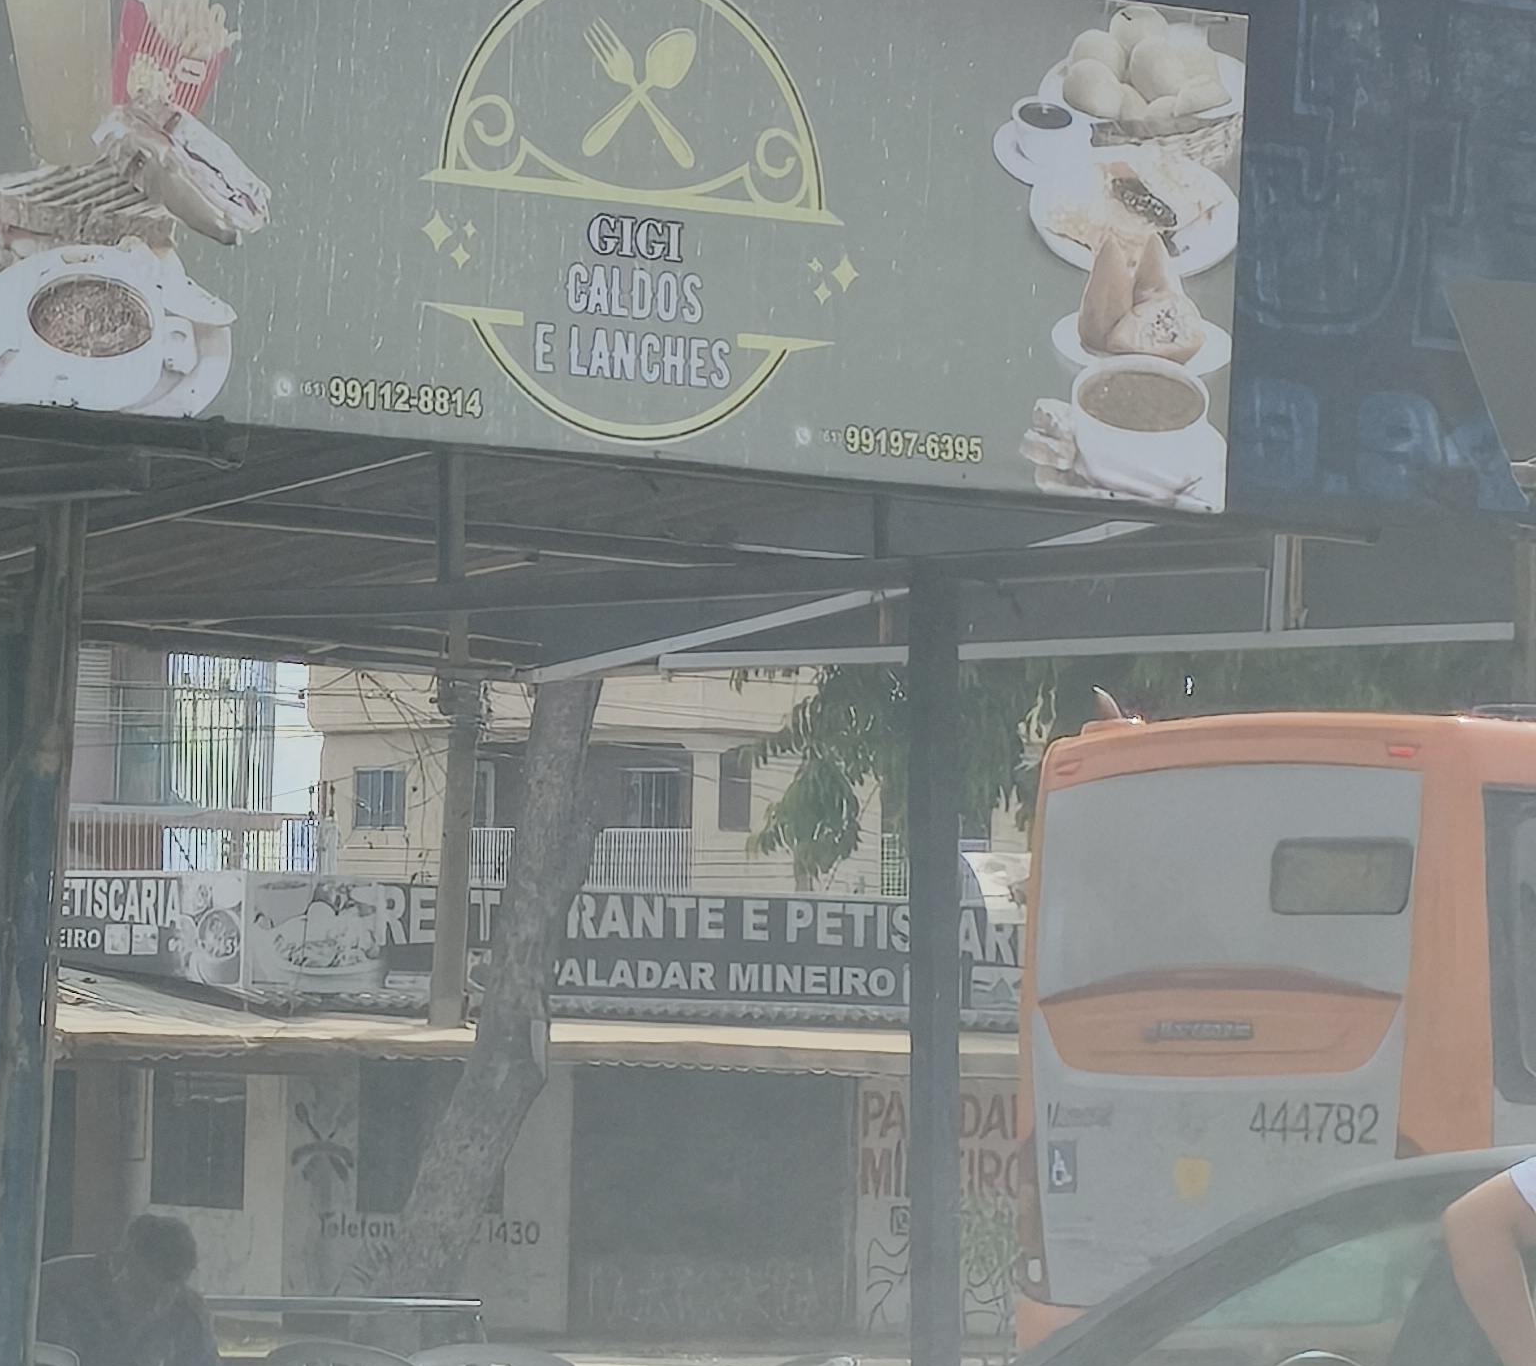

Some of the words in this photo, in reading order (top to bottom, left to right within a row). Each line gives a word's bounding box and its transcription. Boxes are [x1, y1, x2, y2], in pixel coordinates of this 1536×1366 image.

[588, 212, 684, 262] GIGI
[566, 261, 704, 324] CALDOS
[534, 321, 556, 373] E
[569, 324, 731, 390] LANCHES
[329, 376, 484, 418] 99112-8814
[845, 423, 983, 463] 99197-6395
[61, 878, 181, 930] ETISCARIA
[376, 883, 725, 946] RETRANTE
[742, 899, 769, 941] E
[554, 958, 715, 991] ALADAR
[728, 963, 896, 997] MINEIRO
[1249, 1101, 1379, 1146] 444782
